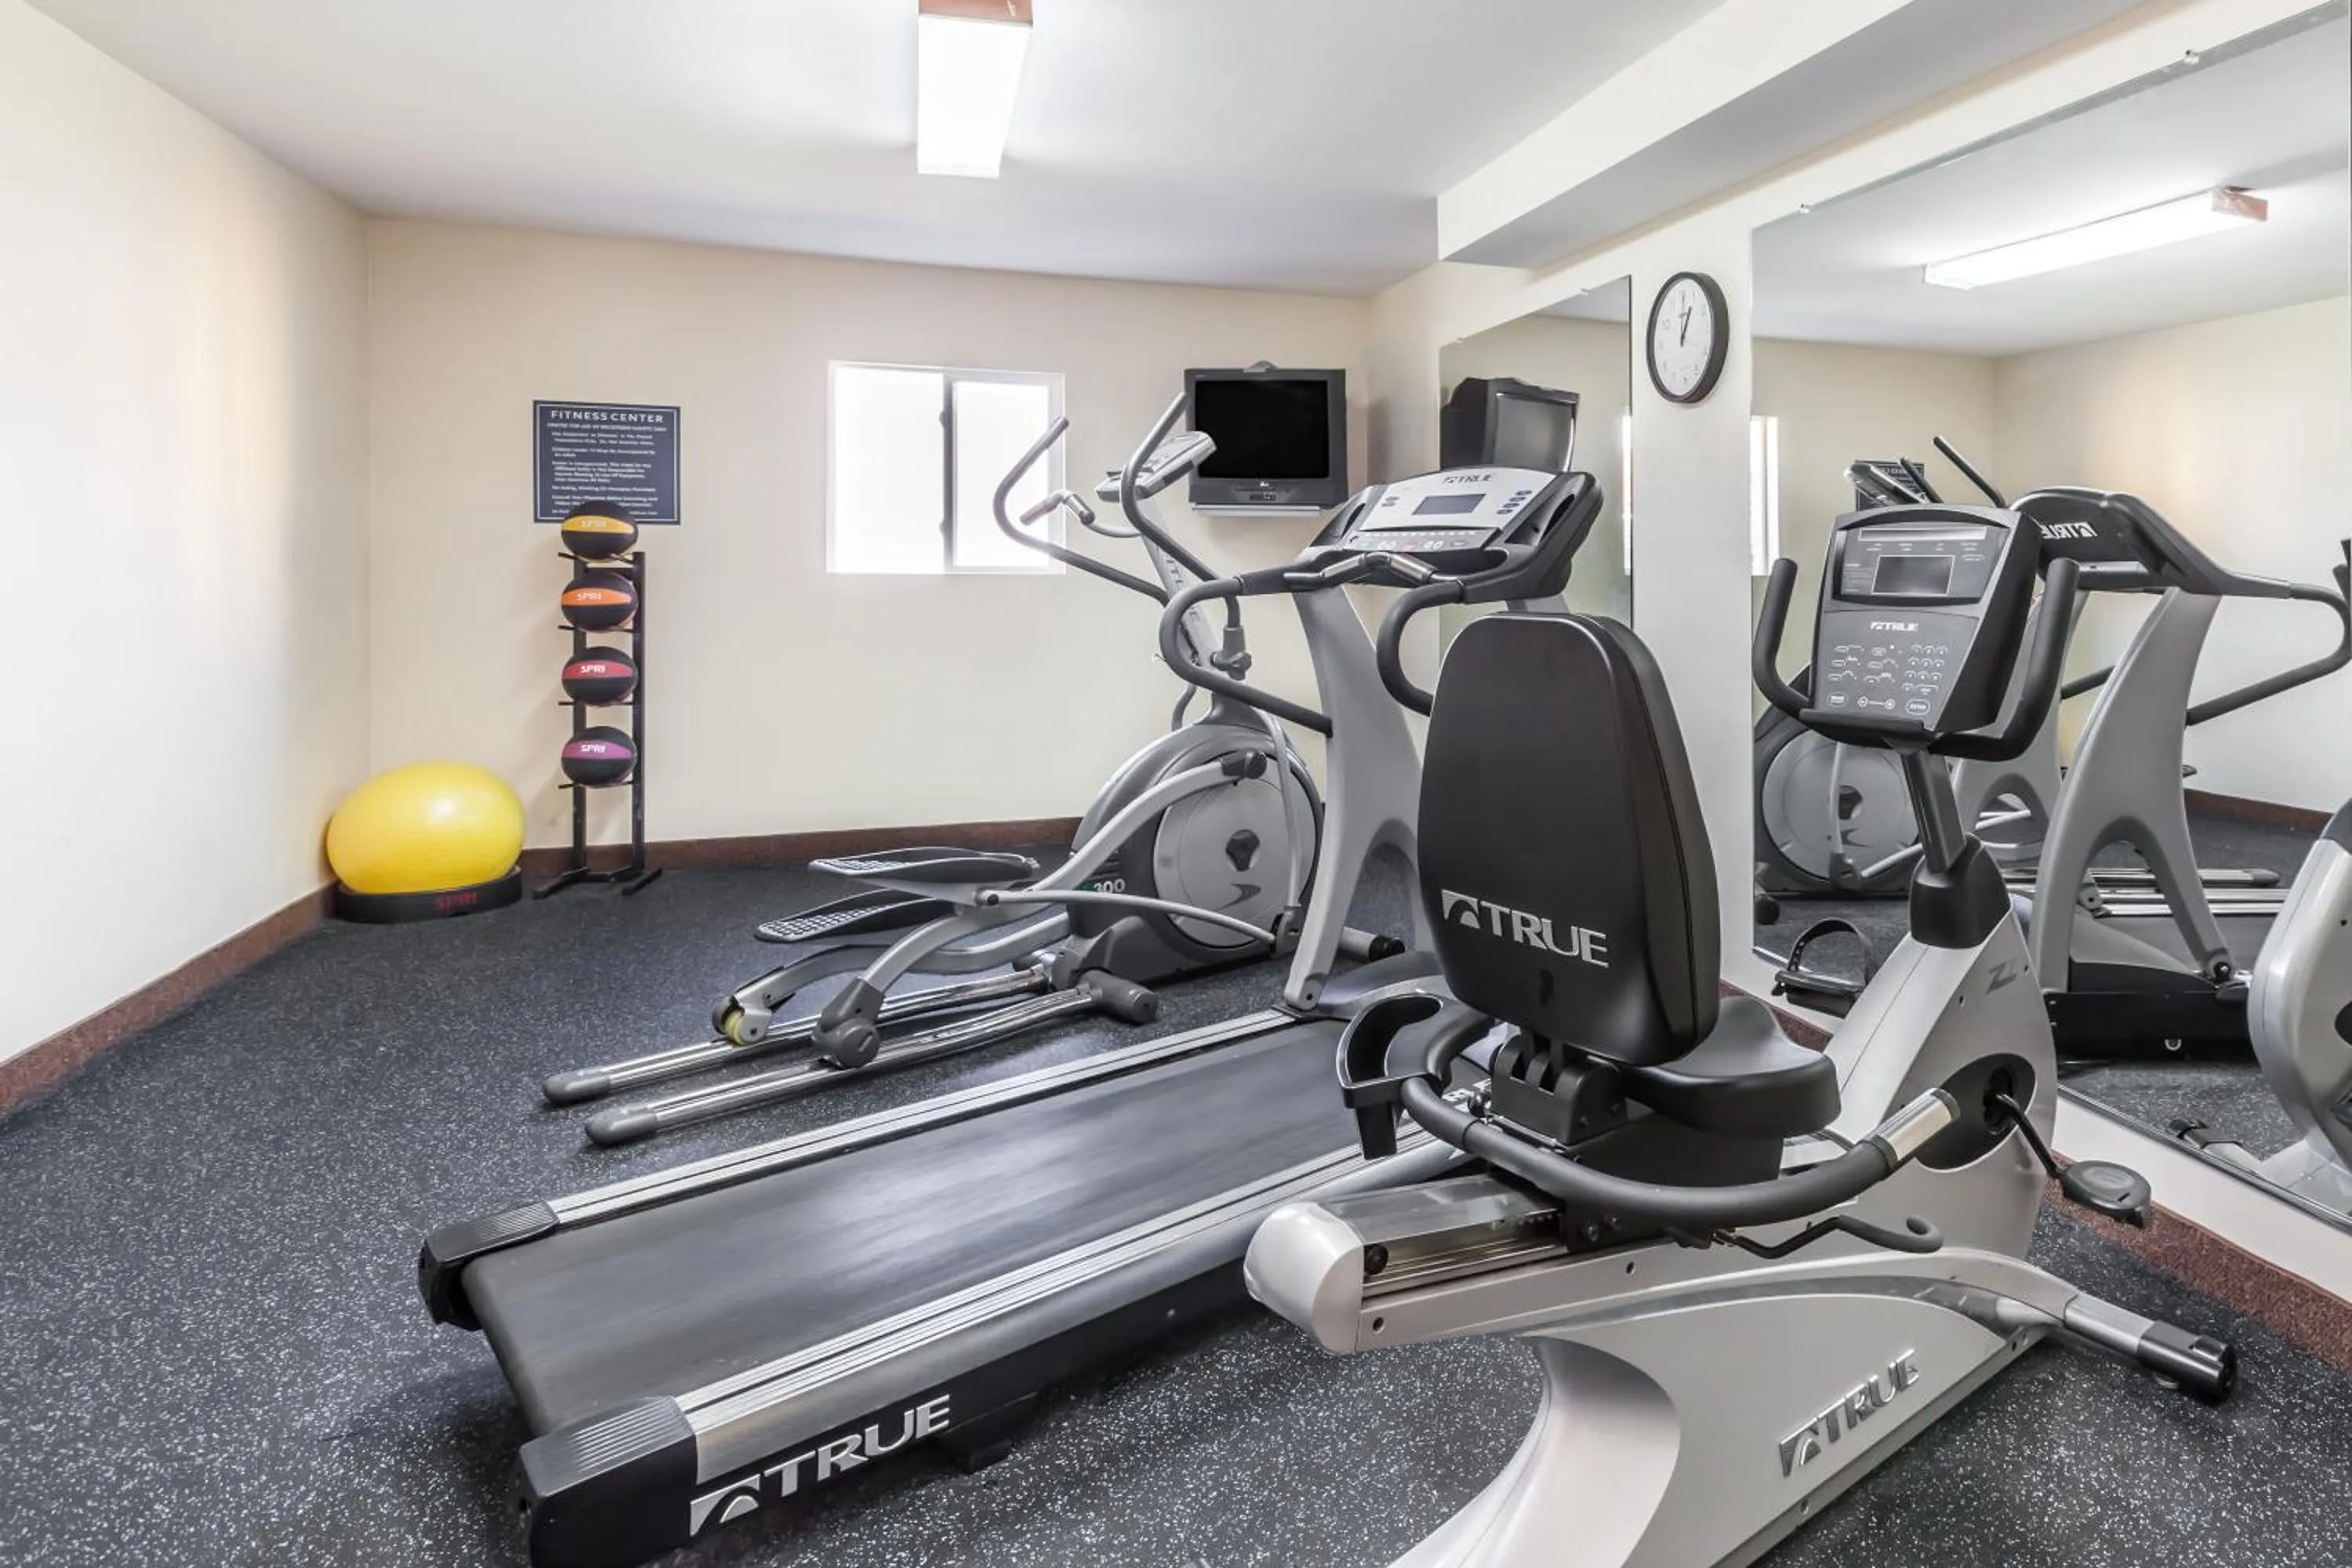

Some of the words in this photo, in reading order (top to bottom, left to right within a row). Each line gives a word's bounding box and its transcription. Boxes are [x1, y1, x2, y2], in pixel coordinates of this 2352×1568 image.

[551, 410, 608, 421] FITNESS
[610, 412, 664, 423] CENTER
[1883, 622, 1919, 632] TRUE
[580, 664, 605, 674] SPRI
[580, 744, 606, 753] SPRI
[1480, 900, 1610, 968] TRUE
[1818, 1348, 1920, 1444] TRUE
[764, 1394, 950, 1497] TRUE
